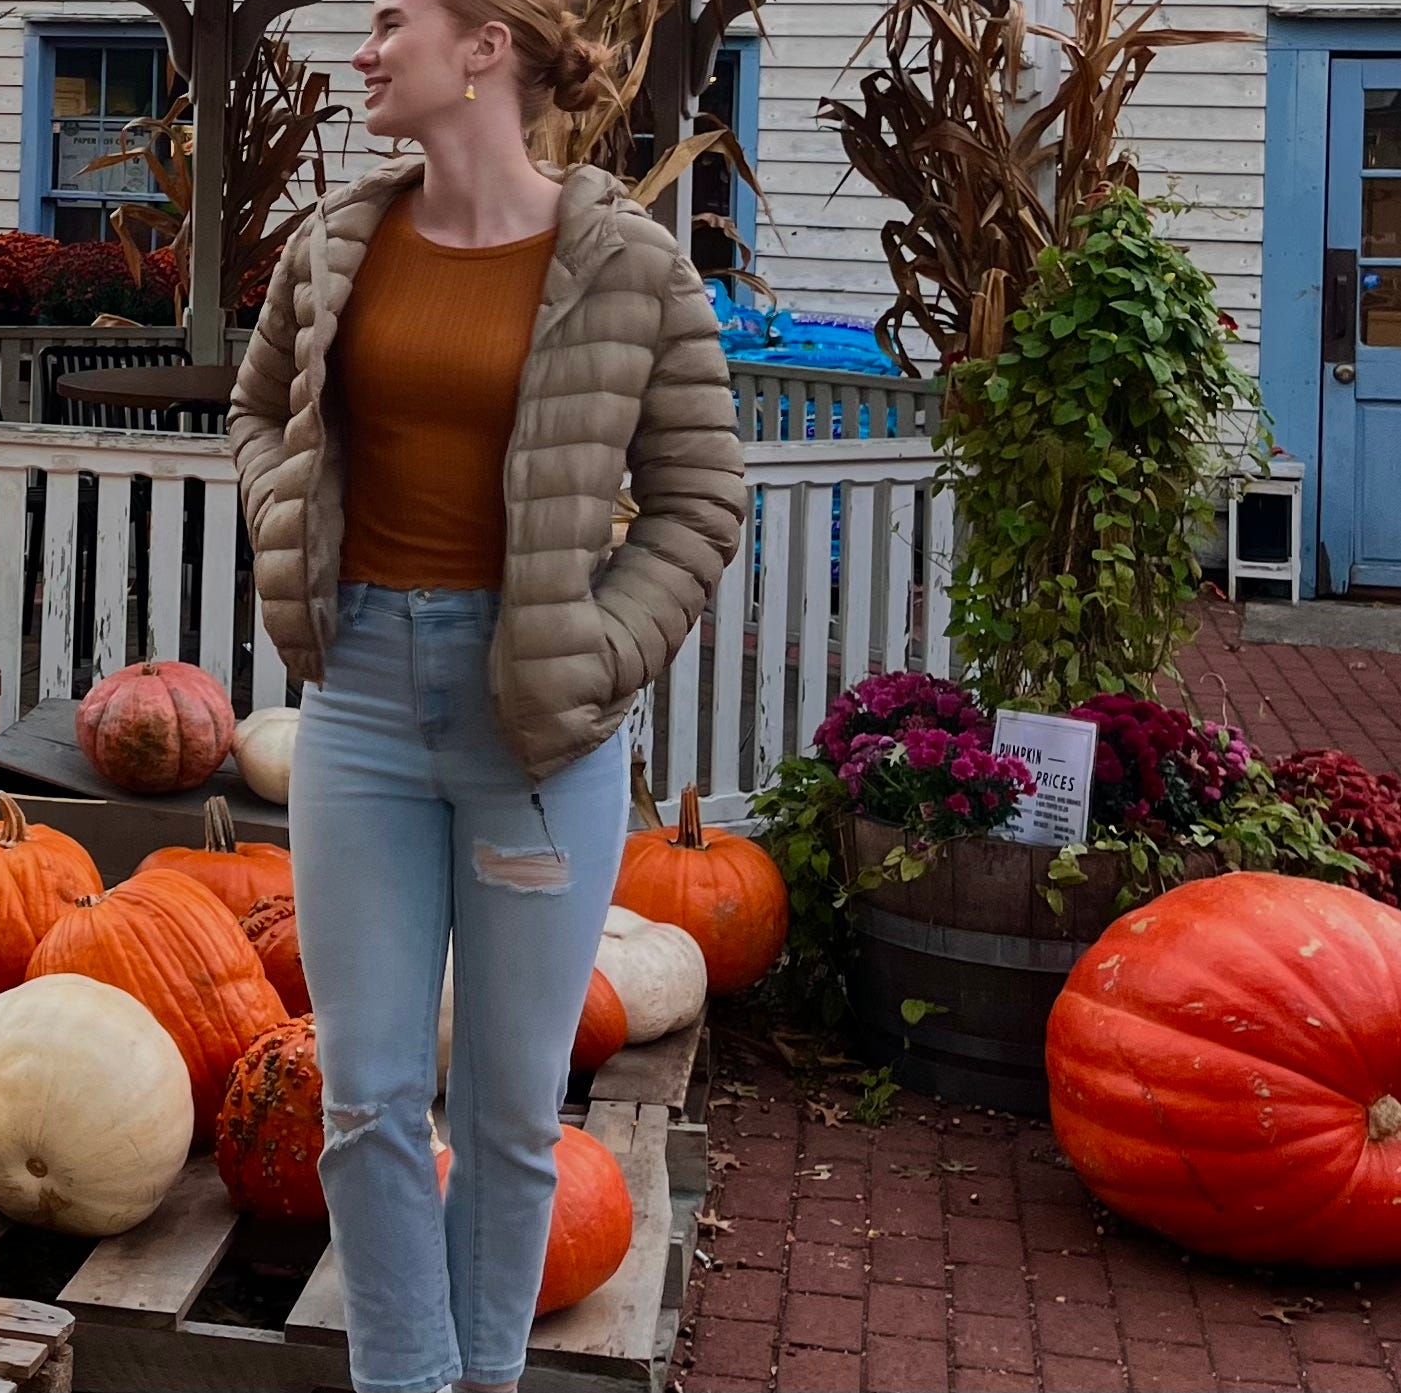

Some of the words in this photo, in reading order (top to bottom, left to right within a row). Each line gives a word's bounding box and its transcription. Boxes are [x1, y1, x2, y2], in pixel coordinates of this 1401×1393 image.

[73, 137, 97, 145] PAPER
[115, 137, 135, 146] CPS
[1035, 771, 1076, 792] PRICES
